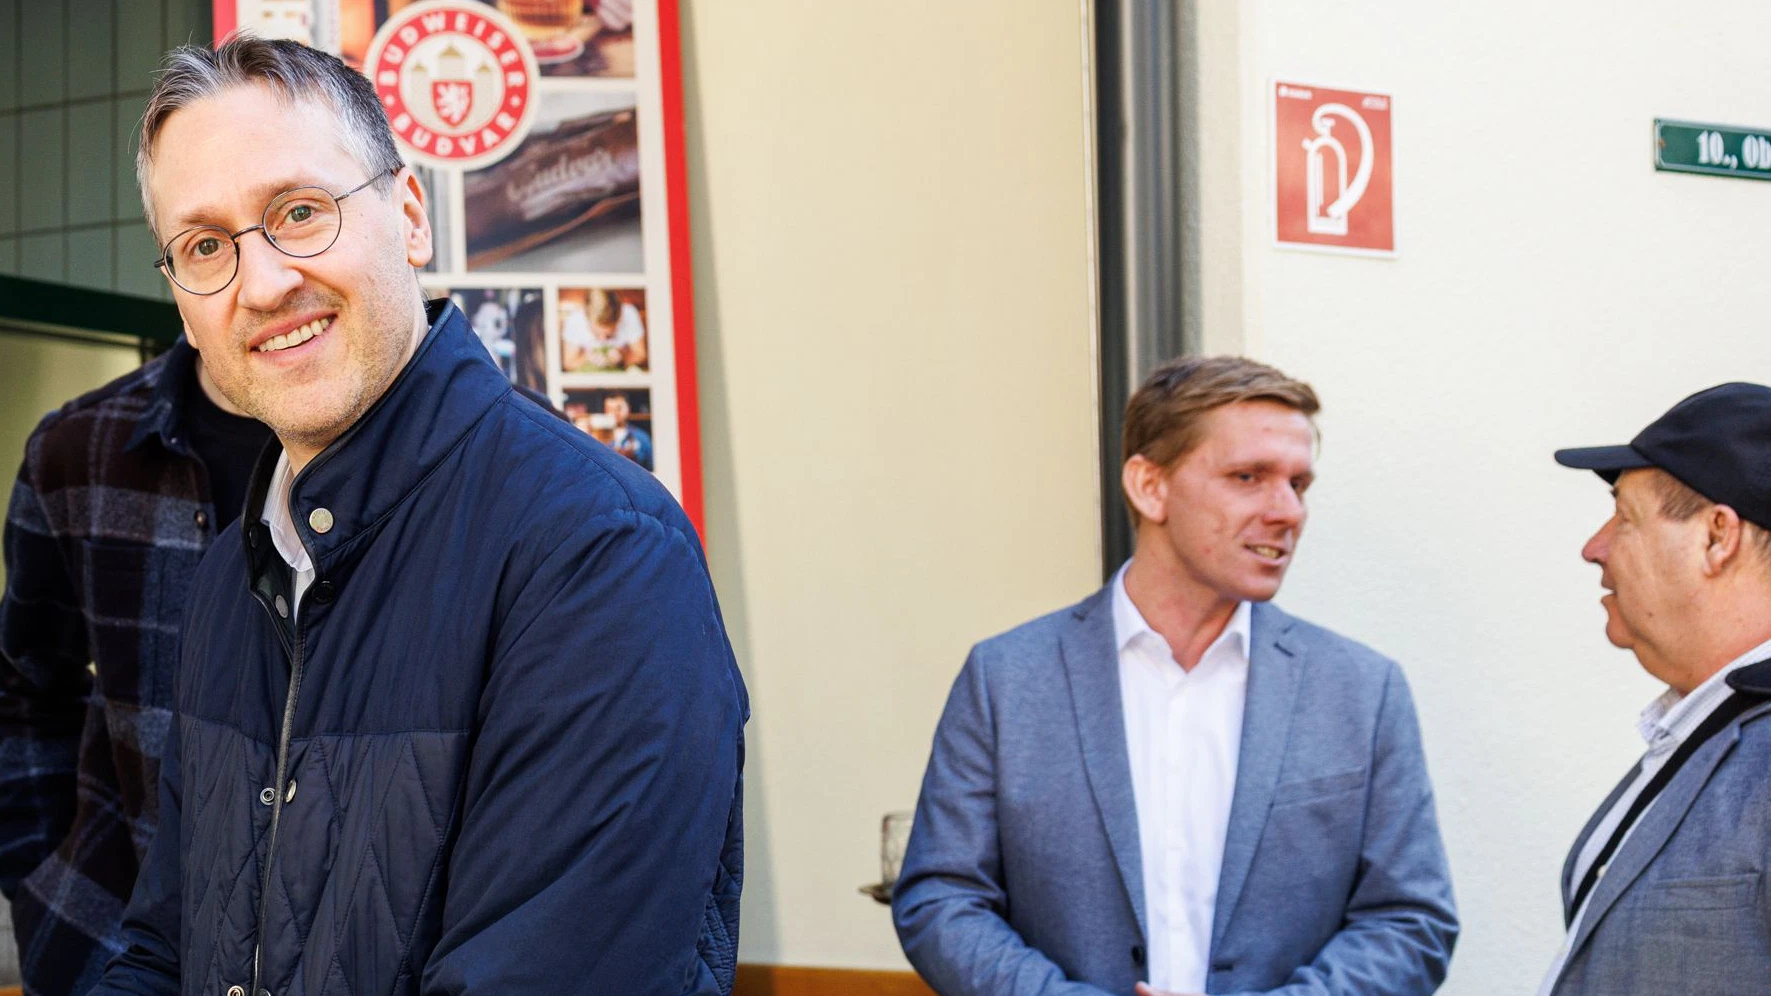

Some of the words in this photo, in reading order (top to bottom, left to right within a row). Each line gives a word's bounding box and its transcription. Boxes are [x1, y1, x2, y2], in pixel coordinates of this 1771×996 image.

[379, 12, 526, 87] BUDWEISER
[392, 112, 517, 157] BUDVAR
[1696, 130, 1738, 170] 10.,
